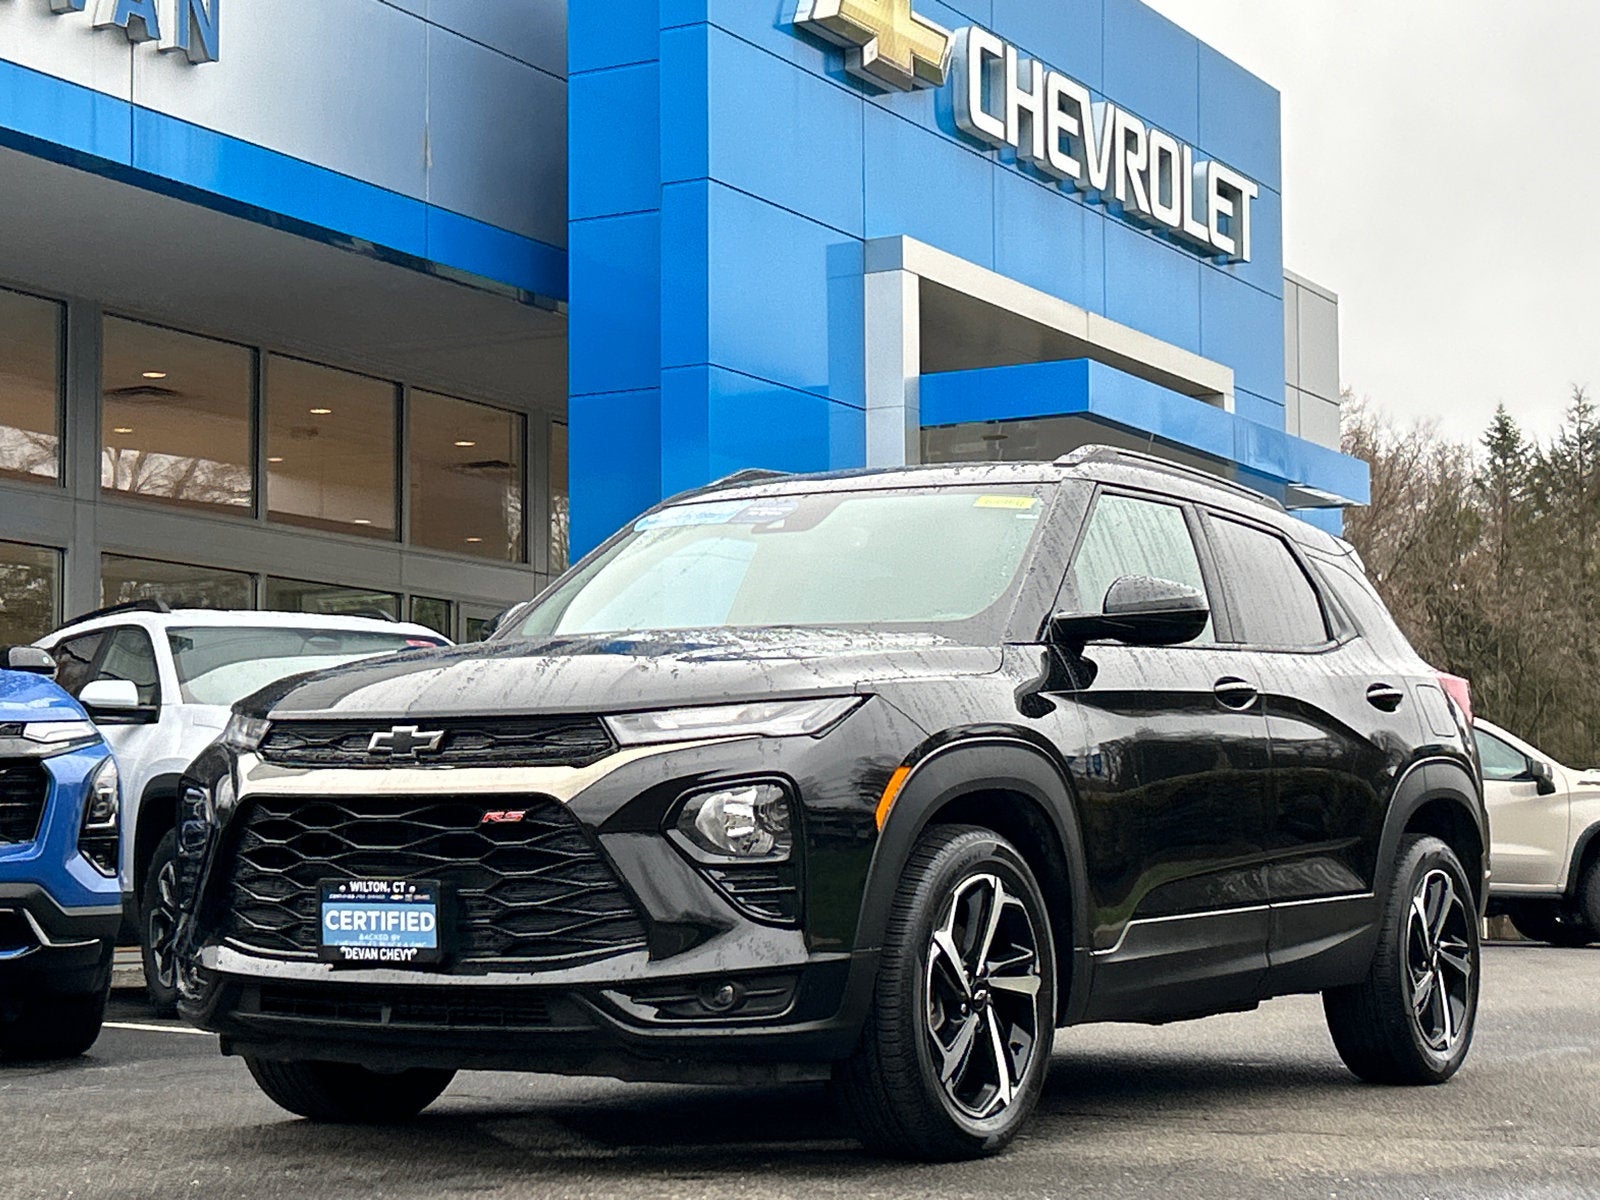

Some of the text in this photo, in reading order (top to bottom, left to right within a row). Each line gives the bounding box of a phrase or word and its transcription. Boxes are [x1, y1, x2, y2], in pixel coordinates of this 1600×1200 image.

[952, 24, 1258, 264] CHEVROLET
[481, 810, 526, 823] RS
[349, 881, 406, 893] WILTON, CT
[324, 909, 436, 932] CERTIFIED
